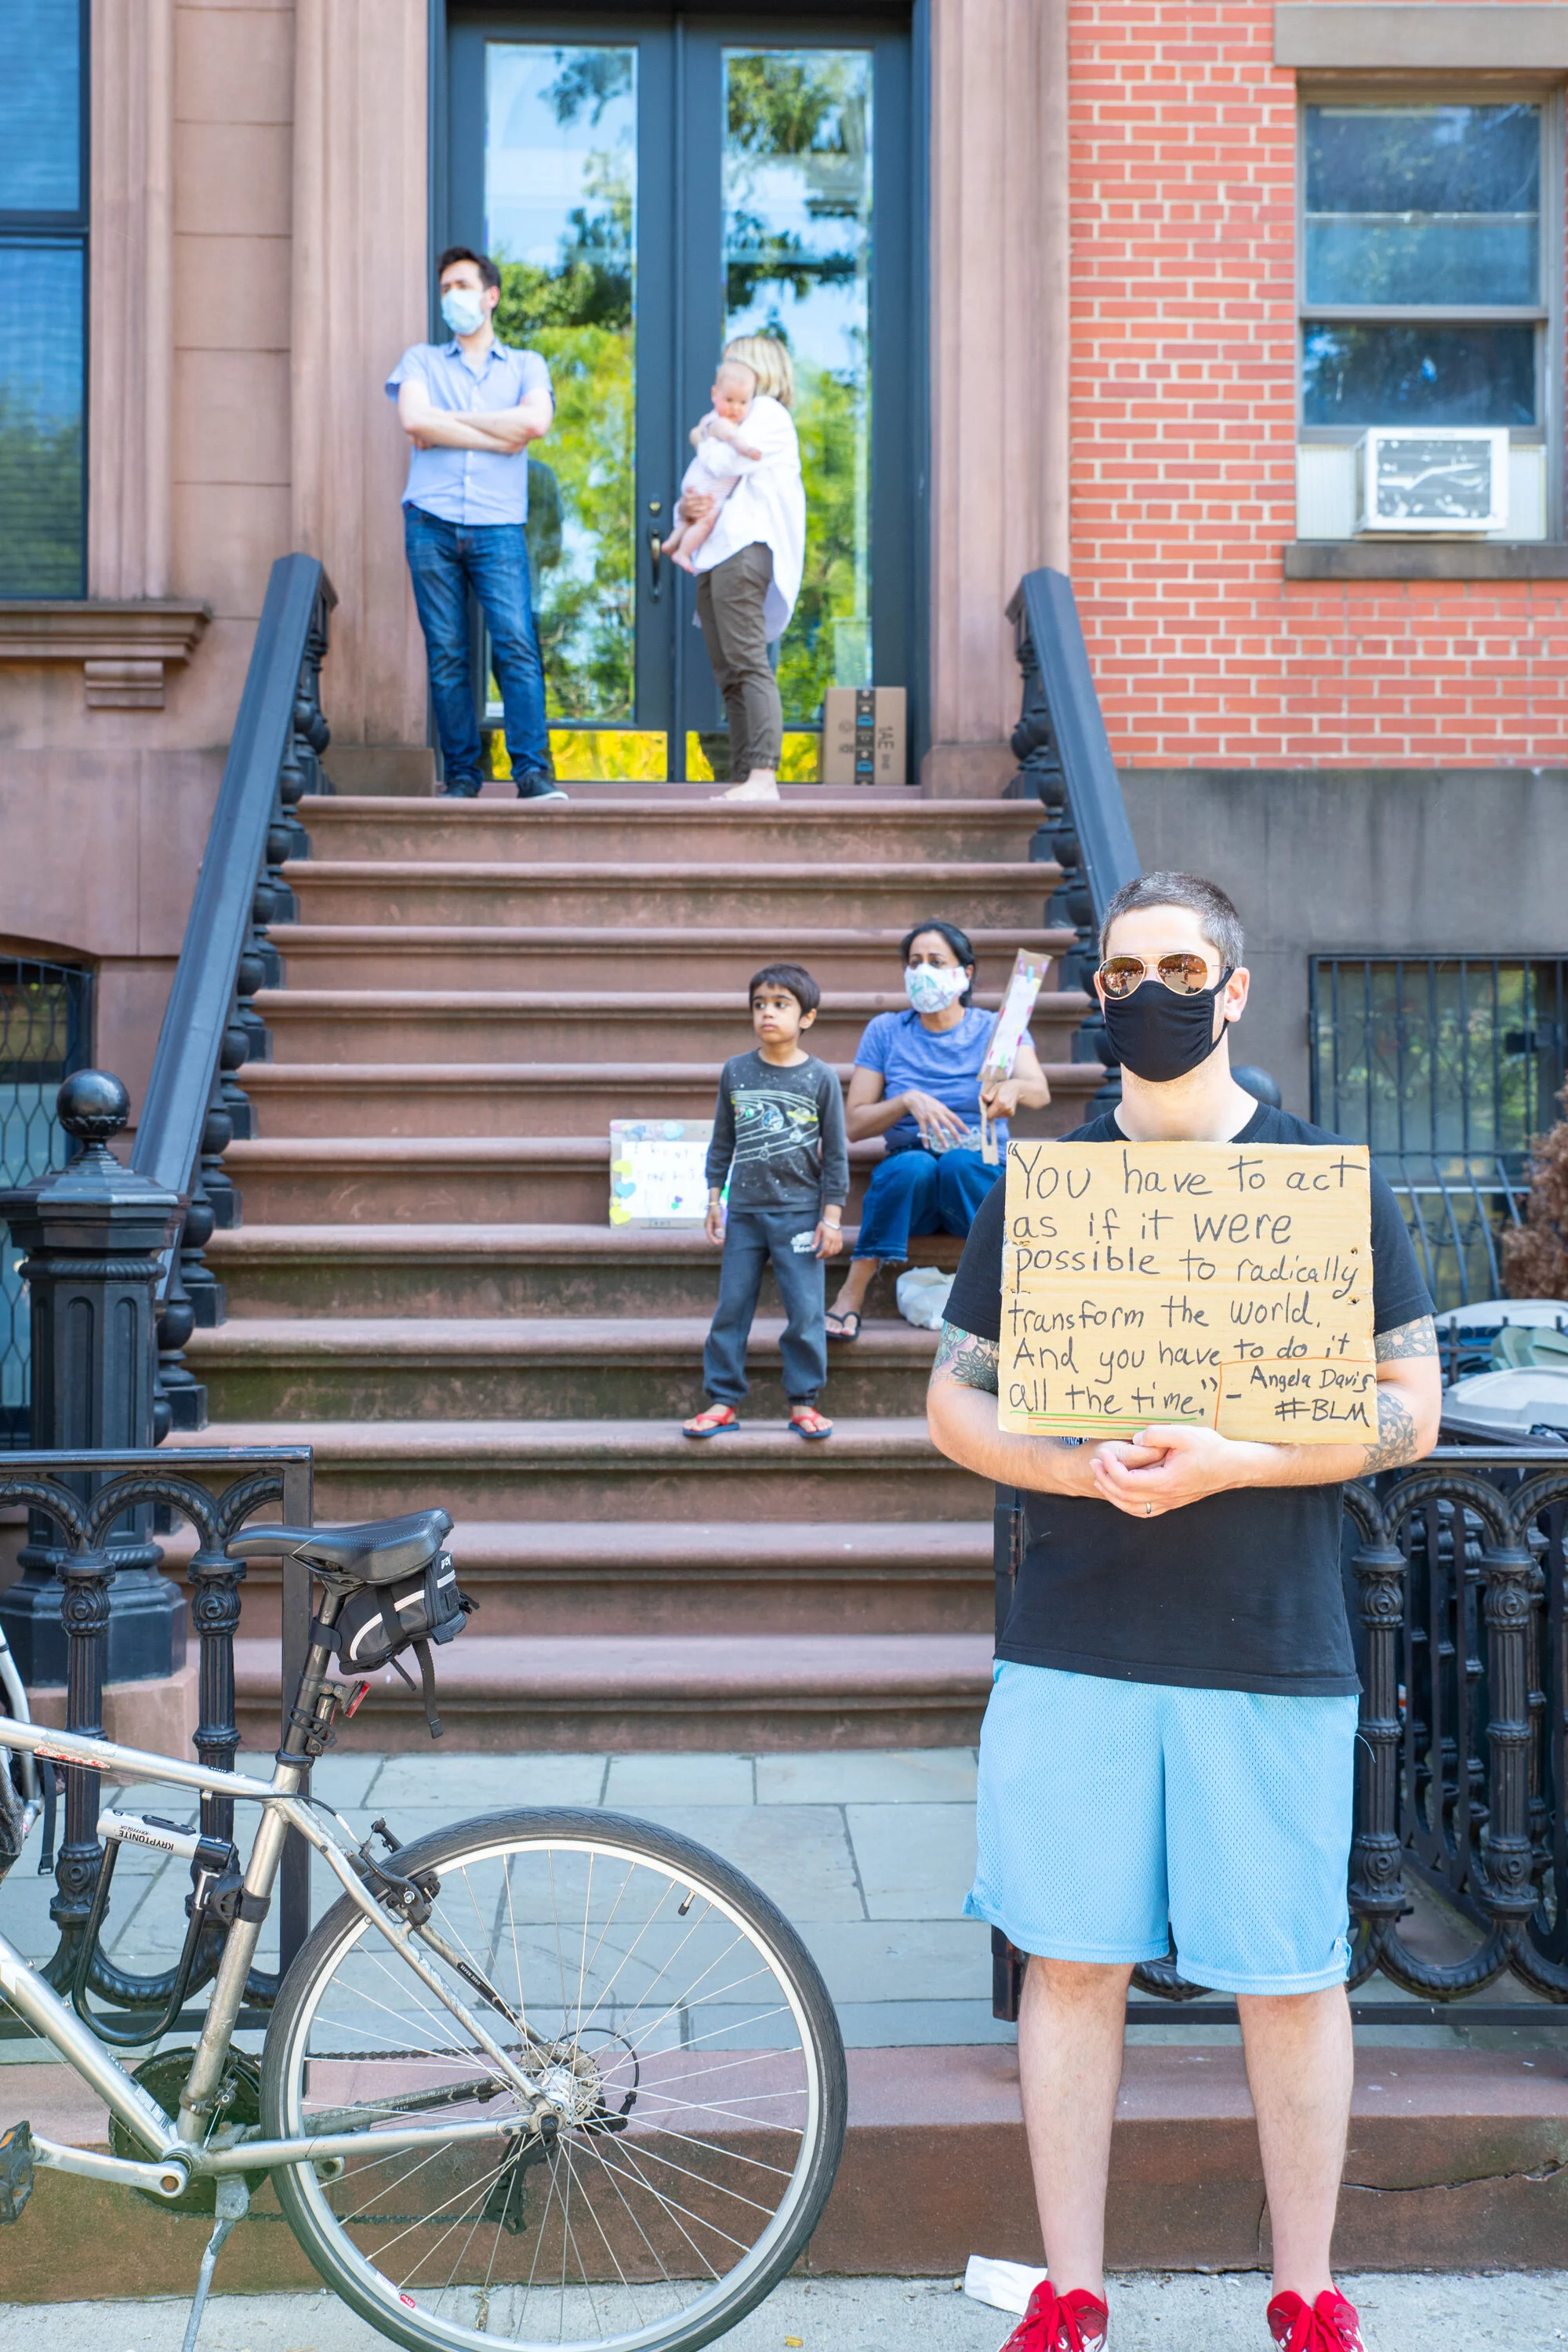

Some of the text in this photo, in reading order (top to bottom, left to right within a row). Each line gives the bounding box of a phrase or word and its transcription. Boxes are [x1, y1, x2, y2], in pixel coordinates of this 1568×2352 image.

[1123, 1149, 1213, 1196] have
[1227, 1155, 1265, 1192] to
[1286, 1155, 1367, 1191] act
[1013, 1207, 1291, 1244] as if it were
[1015, 1240, 1359, 1299] possible to radically
[1007, 1298, 1145, 1337] transform
[1160, 1295, 1210, 1328] the
[1013, 1332, 1350, 1385] And you have to do it
[1250, 1364, 1312, 1393] Angela
[1319, 1368, 1377, 1393] Davis
[1009, 1380, 1047, 1412] all
[1062, 1386, 1123, 1417] the
[1274, 1397, 1370, 1428] #BLM
[118, 1829, 174, 1851] KRYPTONITE
